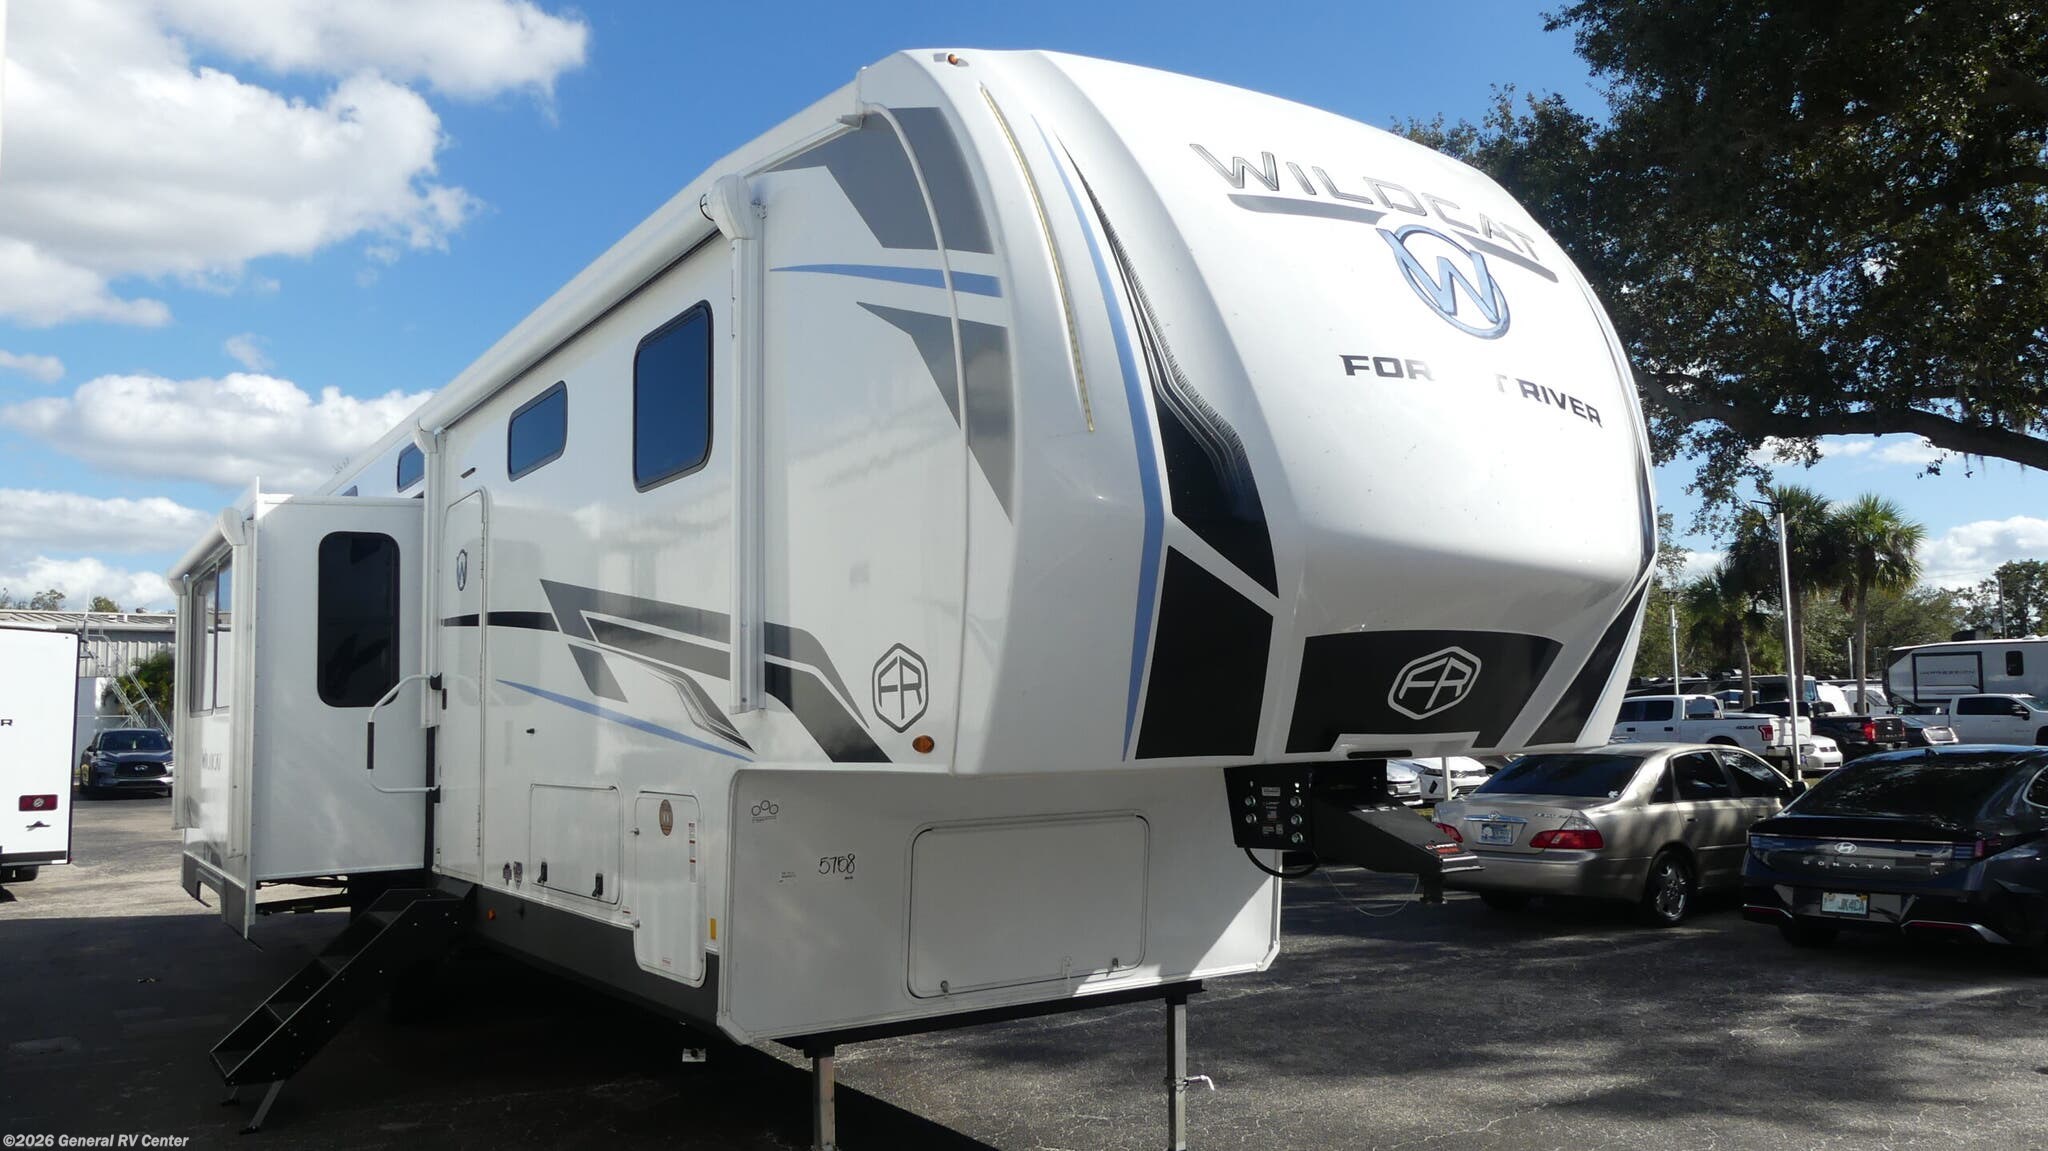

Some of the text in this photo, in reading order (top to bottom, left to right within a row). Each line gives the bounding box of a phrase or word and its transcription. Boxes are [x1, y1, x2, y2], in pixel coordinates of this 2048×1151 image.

[1189, 143, 1537, 262] WILDCAT
[1515, 377, 1604, 428] RIVER
[1802, 859, 1891, 870] SONATA
